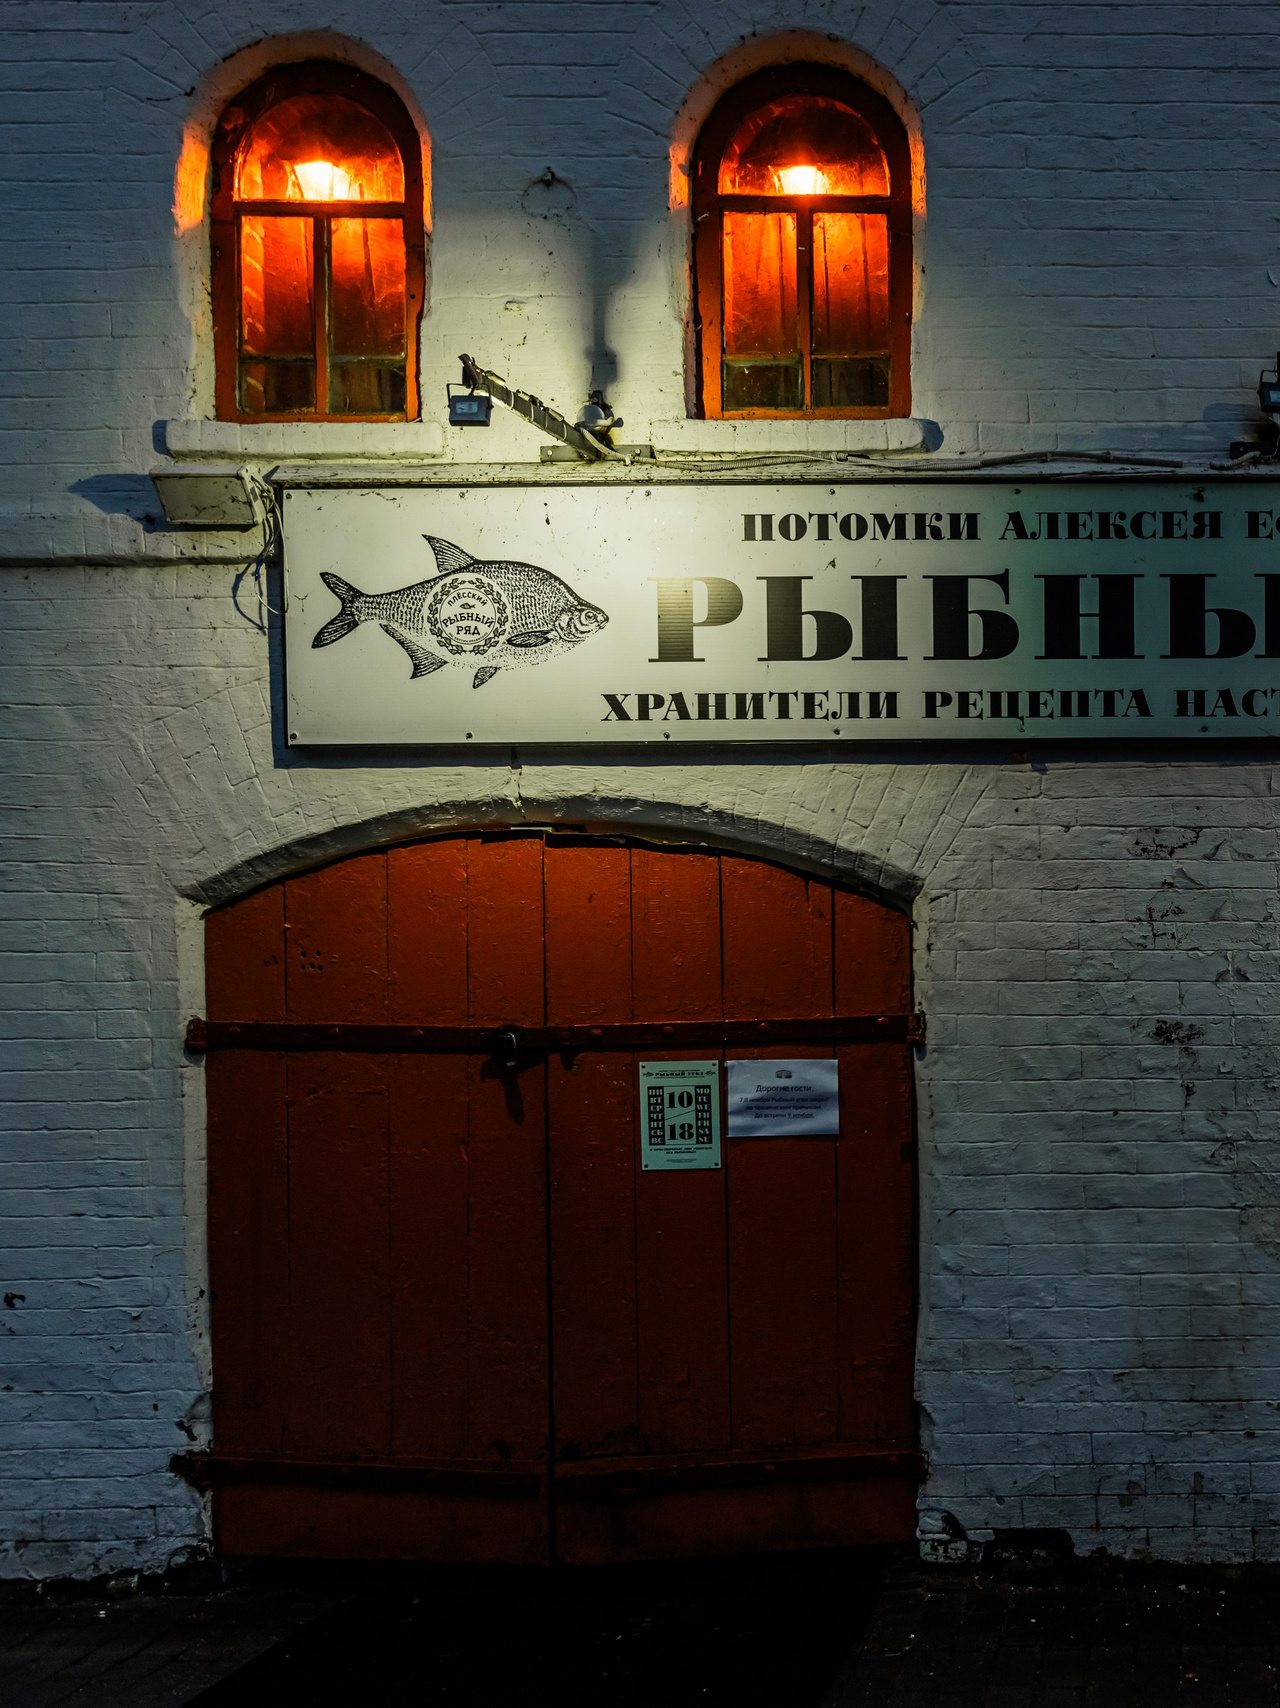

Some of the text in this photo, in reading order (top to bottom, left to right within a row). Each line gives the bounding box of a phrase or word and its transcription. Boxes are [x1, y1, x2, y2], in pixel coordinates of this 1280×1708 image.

[741, 511, 982, 542] ПОТОМКИ
[998, 509, 1224, 542] АЛЕКСЕЯ
[447, 591, 489, 607] ПЛЁССКИЙ
[442, 612, 495, 629] РЫБНЫЙ
[456, 625, 481, 636] РЯД
[601, 690, 901, 722] ХРАНИТЕЛИ
[921, 688, 1155, 727] РЕЦЕПТА
[649, 1088, 663, 1096] ПН
[755, 1084, 789, 1093] Дорогие
[650, 1096, 663, 1104] ВТ
[666, 1090, 694, 1109] 10
[650, 1104, 663, 1112] СР
[696, 1103, 711, 1111] WE
[696, 1111, 710, 1119] TH
[667, 1122, 694, 1141] 18
